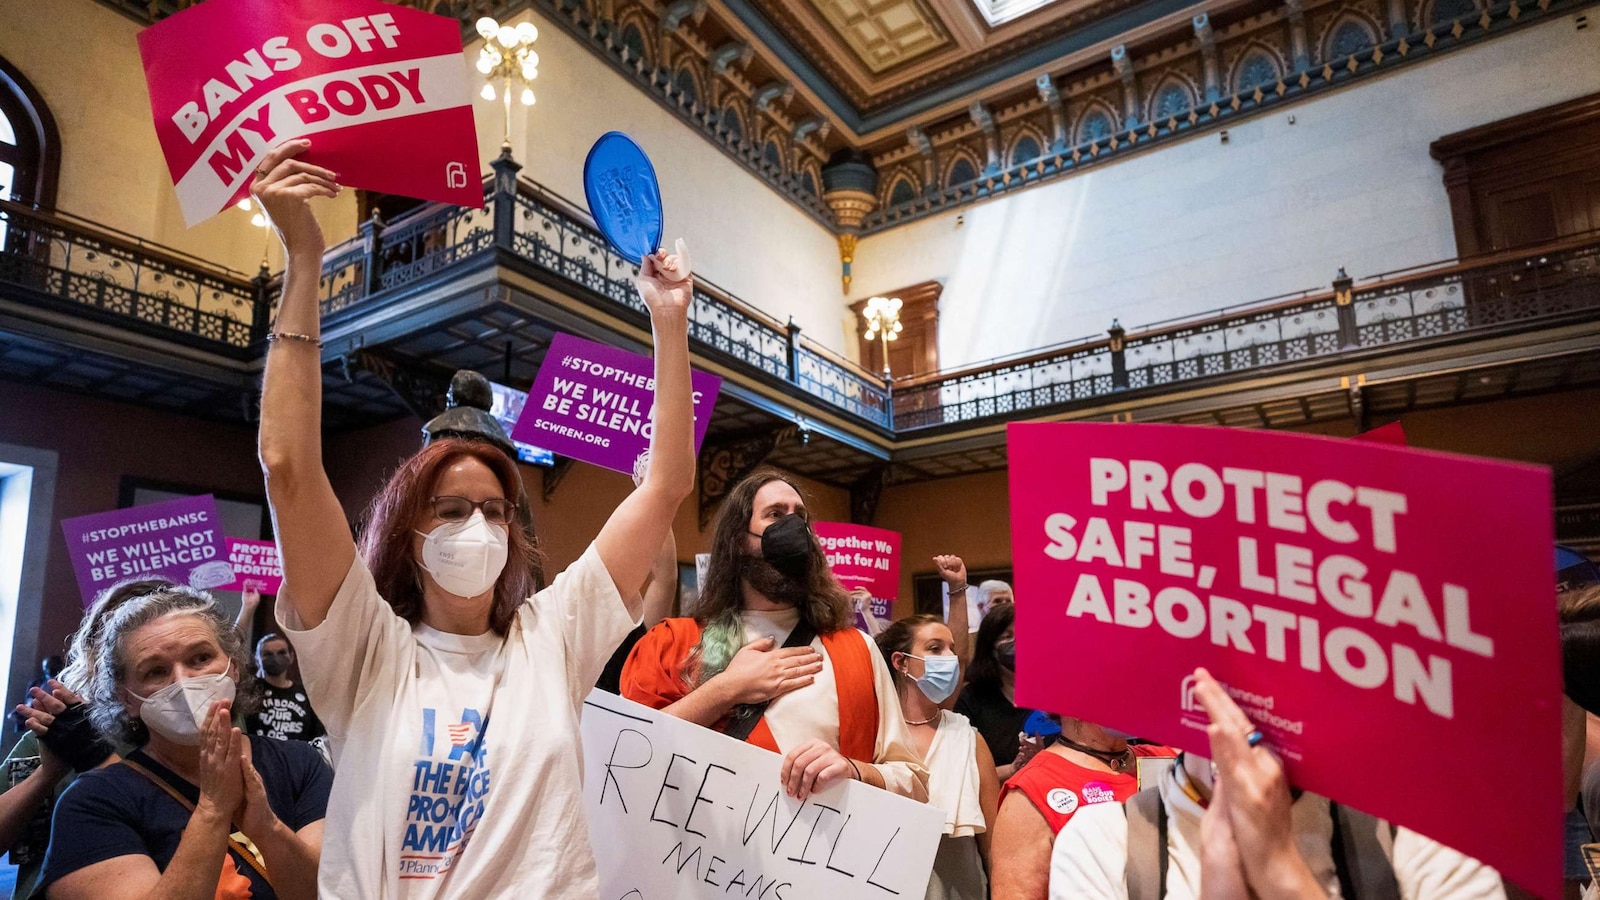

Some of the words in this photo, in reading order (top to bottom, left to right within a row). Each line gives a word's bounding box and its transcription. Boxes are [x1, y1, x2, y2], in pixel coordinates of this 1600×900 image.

[172, 36, 302, 144] BANS
[306, 12, 401, 59] OFF
[207, 102, 277, 188] MY
[285, 68, 425, 125] BODY
[542, 393, 574, 416] BE
[575, 403, 652, 439] SILENC
[552, 376, 588, 400] WE
[592, 388, 642, 416] WILL
[534, 418, 611, 448] SCWREN.ORG
[1089, 456, 1408, 555] PROTECT
[81, 511, 208, 544] #STOPTHEBANSC
[86, 548, 120, 567] WE
[122, 539, 172, 559] WILL
[174, 529, 215, 550] NOT
[815, 534, 874, 551] ogether
[874, 540, 893, 555] We
[90, 564, 117, 582] BE
[120, 545, 217, 576] SILENCED
[854, 553, 874, 568] for
[874, 557, 890, 571] All
[1043, 511, 1217, 589] SAFE,
[1237, 535, 1495, 659] LEGAL
[1065, 572, 1455, 721] ABORTION
[418, 707, 436, 758] I
[413, 760, 454, 796] THE
[662, 841, 793, 900] MEANS
